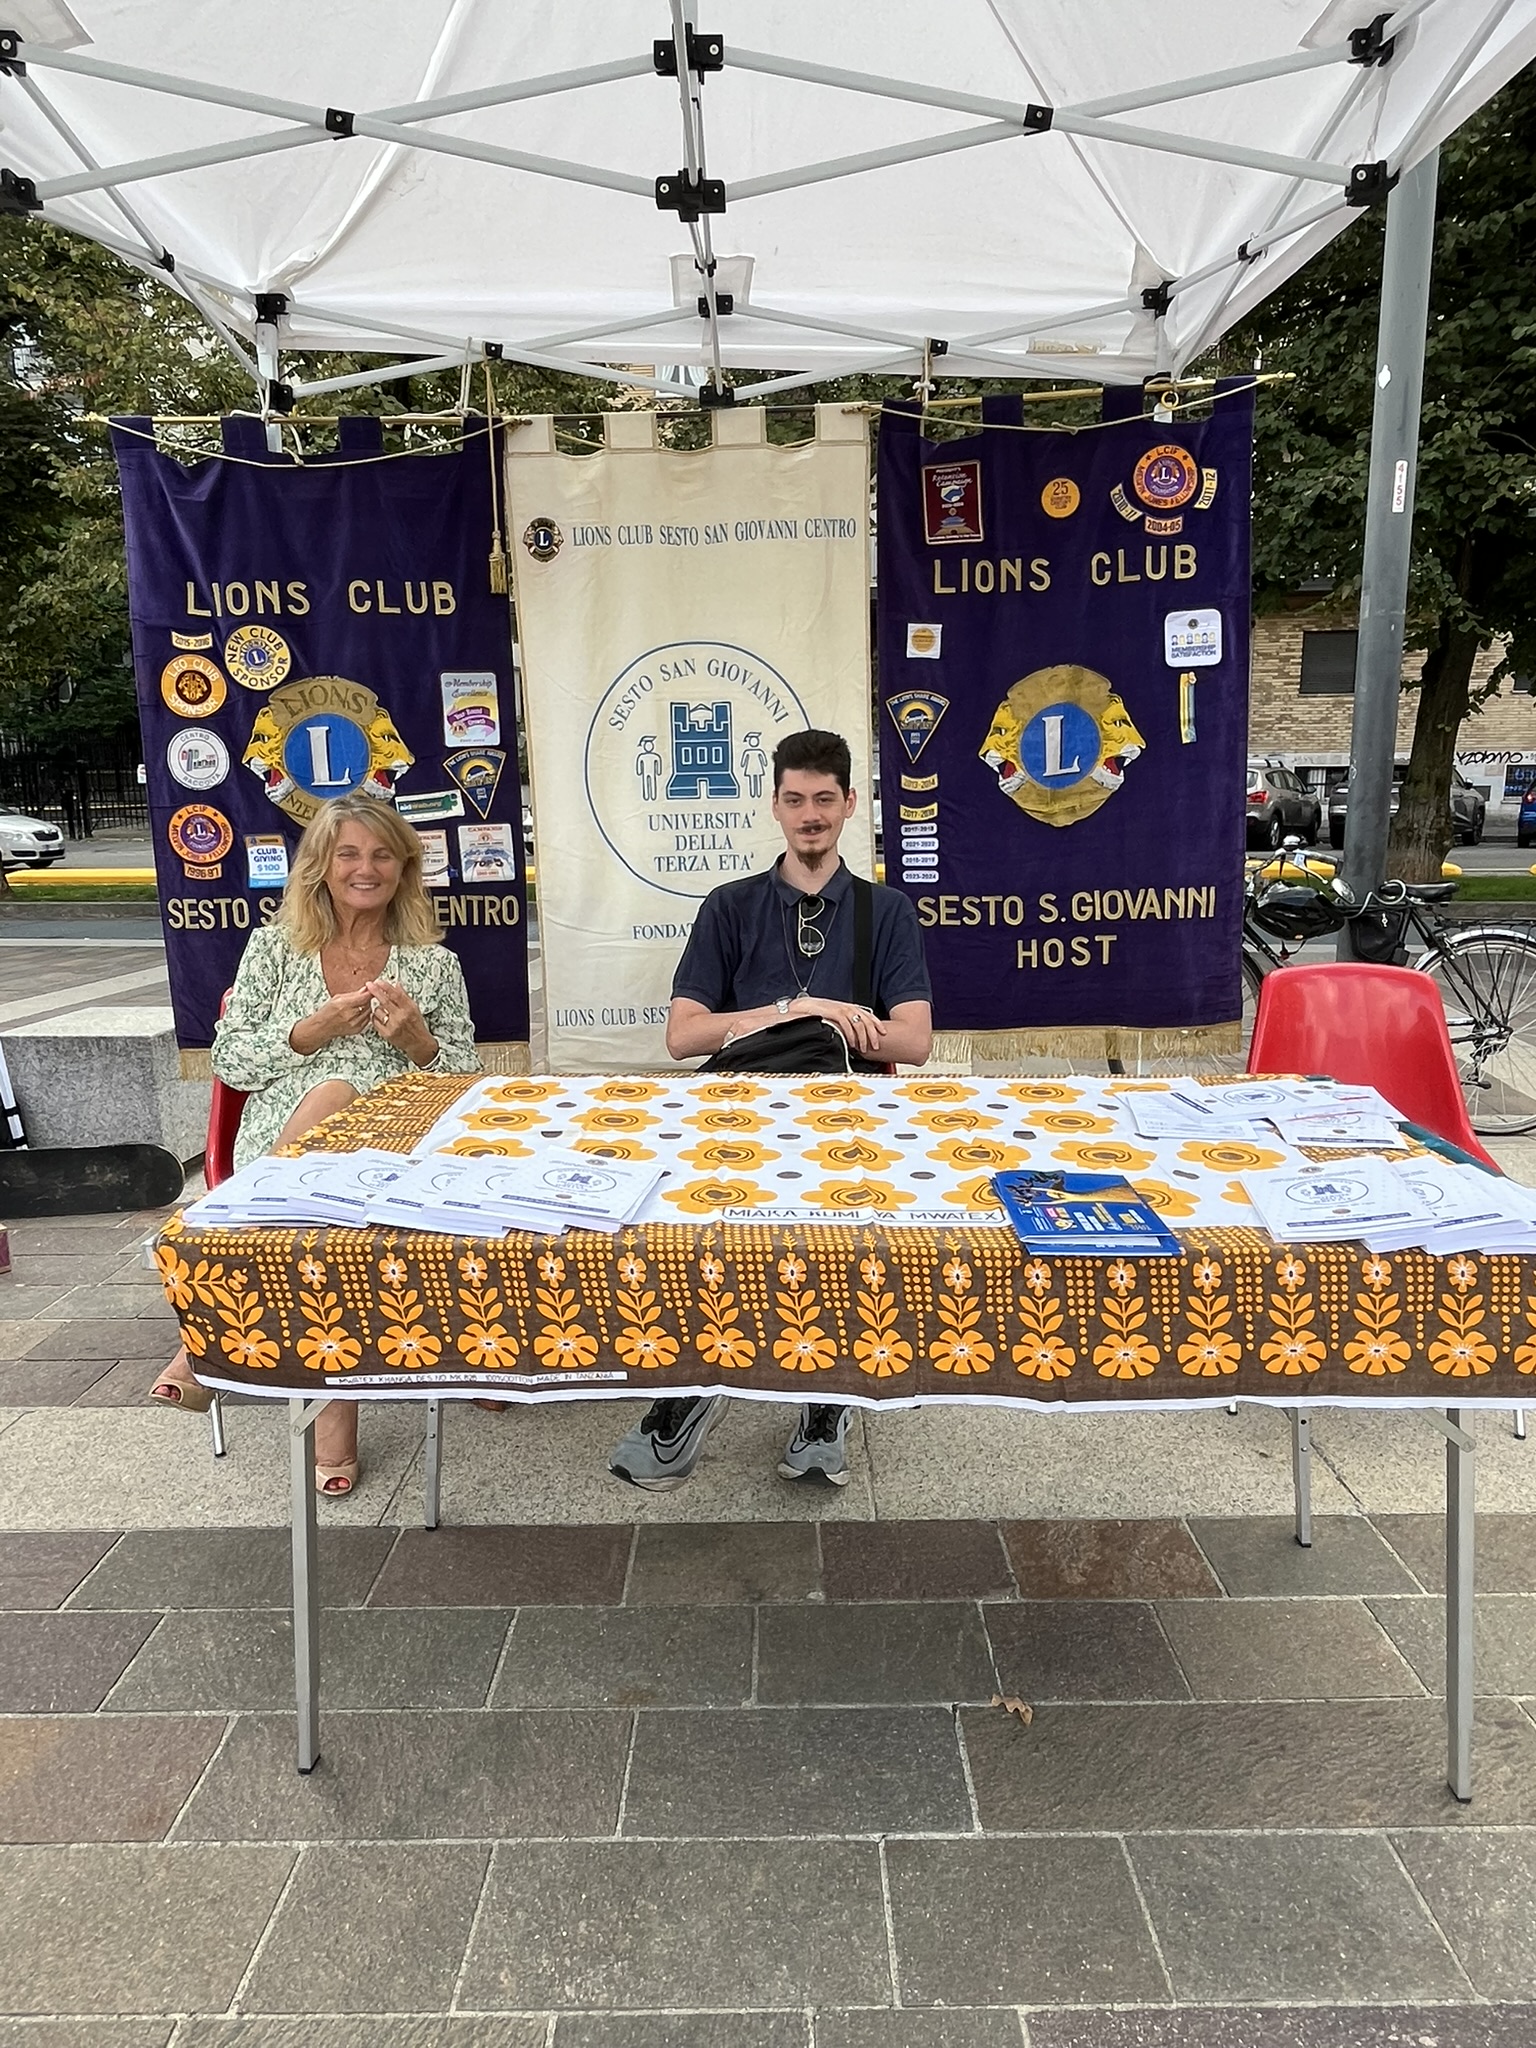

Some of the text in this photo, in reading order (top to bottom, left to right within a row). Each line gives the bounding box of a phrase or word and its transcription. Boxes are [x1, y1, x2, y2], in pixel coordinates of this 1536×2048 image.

[1156, 446, 1180, 456] LCIF
[1053, 481, 1069, 495] 25
[1112, 488, 1137, 519] 2010-11
[1199, 472, 1216, 506] 2011-12
[572, 518, 857, 547] LIONS CLUB SESTO SAN GIOVANNI CENTRO
[933, 544, 1198, 594] LIONS CLUB
[186, 580, 457, 617] LIONS CLUB
[227, 627, 284, 663] NEW CLUB
[167, 659, 220, 682] LEO CLUB
[233, 657, 288, 687] SPONSOR
[169, 694, 218, 715] SPONSOR
[281, 685, 368, 718] LIONS
[608, 658, 789, 731] SESTO SAN GIOVANNI
[306, 726, 351, 786] L
[1042, 715, 1080, 777] L
[648, 809, 756, 832] UNIVERSITA'
[675, 833, 733, 851] DELLA
[654, 852, 754, 872] TERZA ETA'
[167, 897, 250, 929] SESTO
[433, 895, 519, 926] ENTRO
[917, 895, 1024, 927] SESTO
[1017, 935, 1117, 969] HOST
[556, 1008, 595, 1027] LIONS
[601, 1007, 637, 1026] CLUB
[729, 1208, 798, 1218] MIAKA
[872, 1210, 896, 1220] YA
[910, 1211, 998, 1221] MWATEX
